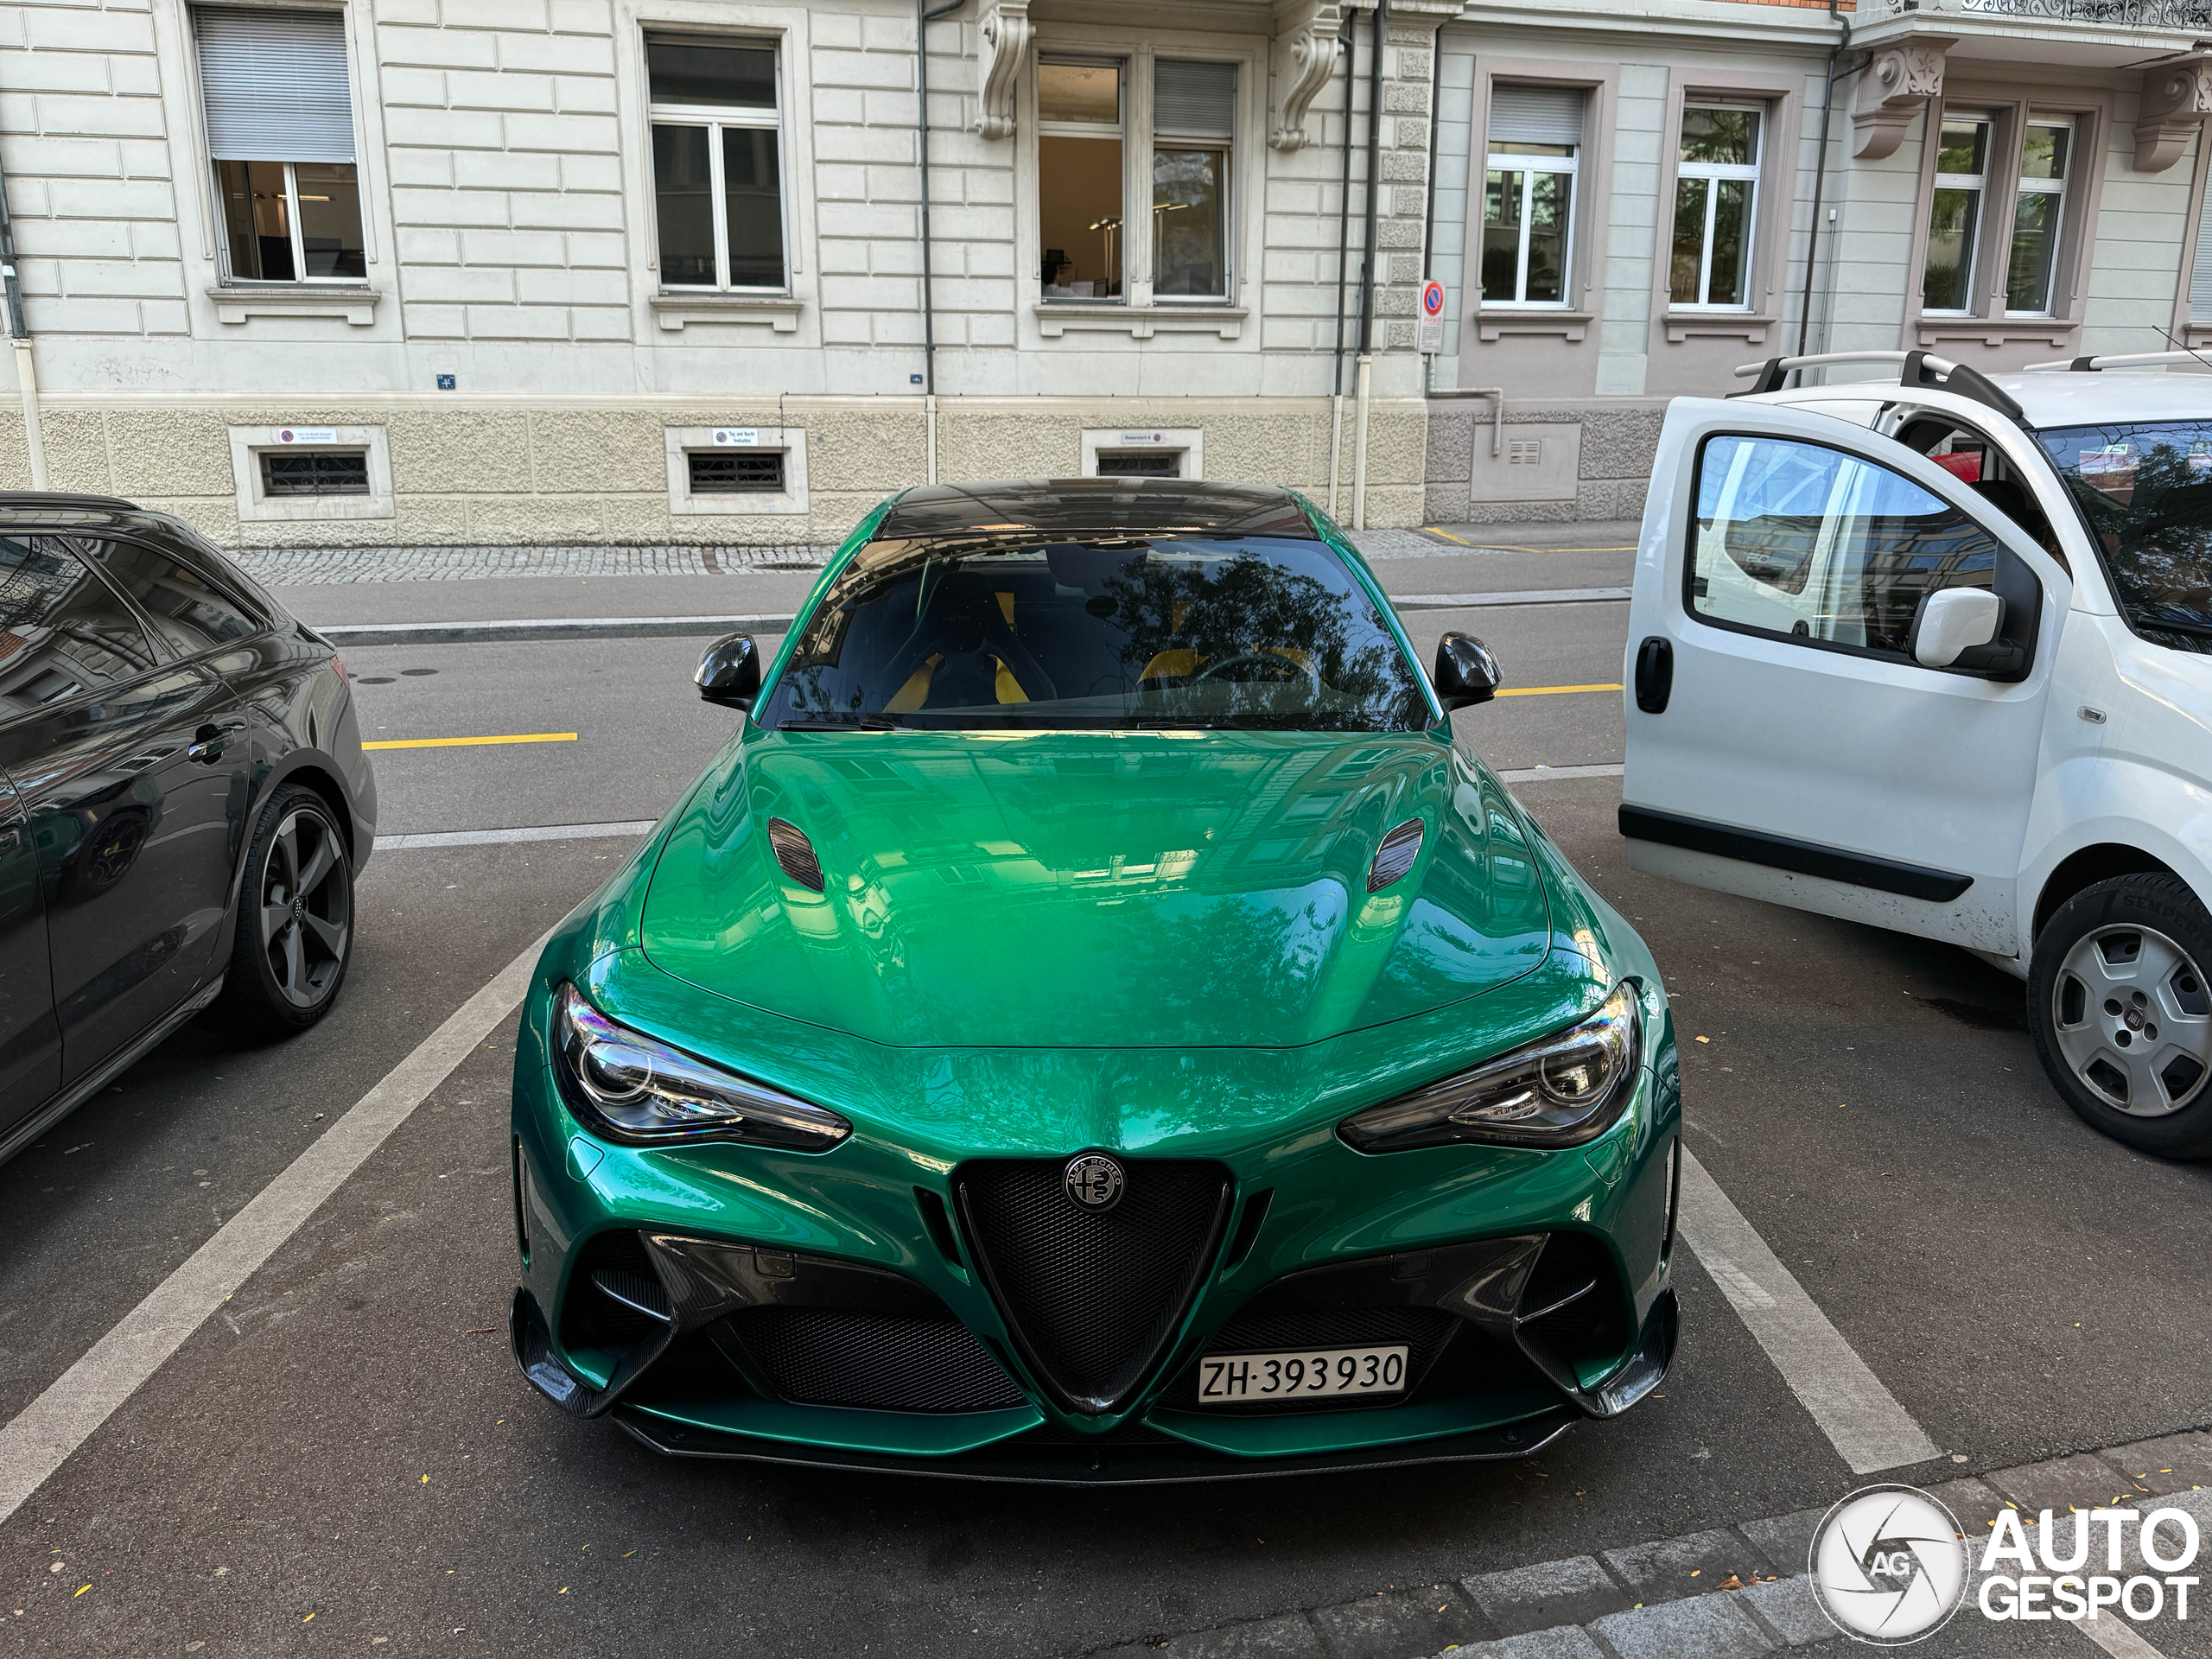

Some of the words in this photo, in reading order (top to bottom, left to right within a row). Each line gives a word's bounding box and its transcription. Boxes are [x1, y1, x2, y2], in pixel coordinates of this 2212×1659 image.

[2126, 1012, 2141, 1027] FIAT
[1068, 1162, 1087, 1185] ALFA
[1090, 1159, 1122, 1185] ROMEO
